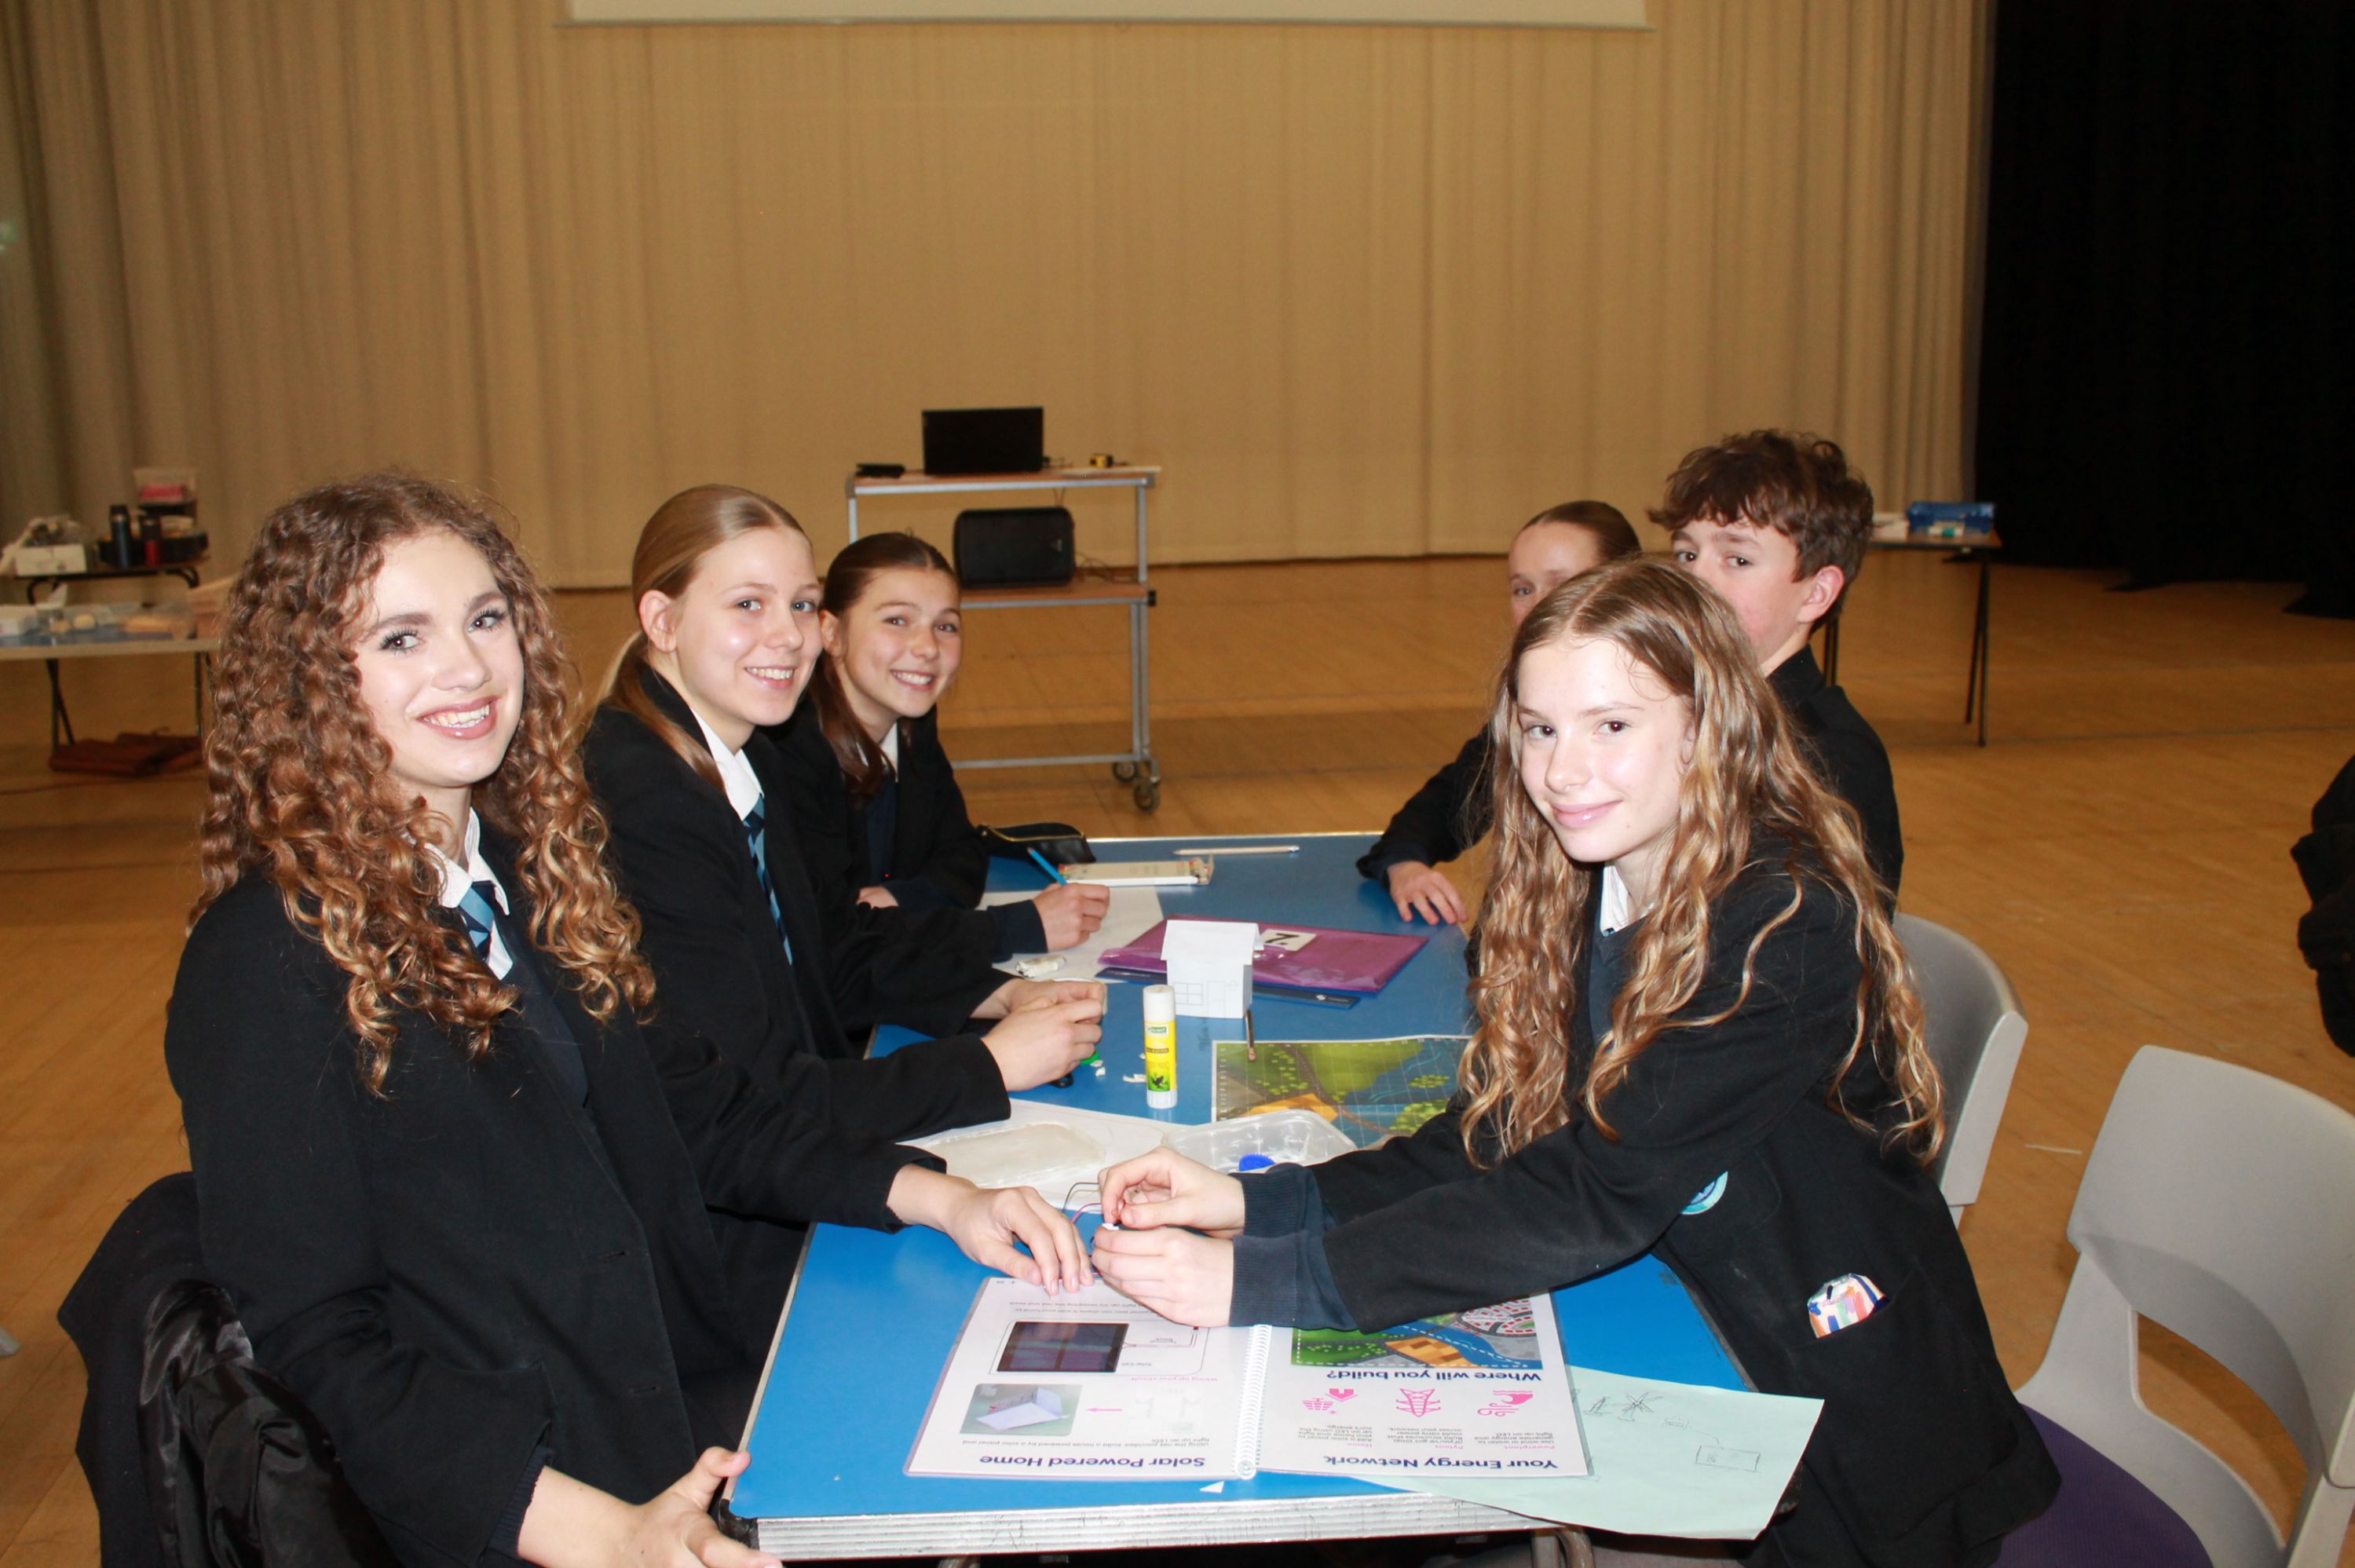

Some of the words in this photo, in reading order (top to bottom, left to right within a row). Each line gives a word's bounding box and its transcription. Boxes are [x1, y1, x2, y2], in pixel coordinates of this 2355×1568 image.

[1326, 1370, 1388, 1380] build?
[1395, 1369, 1431, 1379] you
[1435, 1372, 1469, 1380] will
[1474, 1372, 1541, 1381] Where
[979, 1456, 1043, 1467] Home
[1048, 1457, 1144, 1467] Powered
[1148, 1457, 1206, 1467] Solar
[1324, 1456, 1418, 1468] Network
[1424, 1457, 1501, 1469] Energy
[1507, 1460, 1558, 1469] Your
